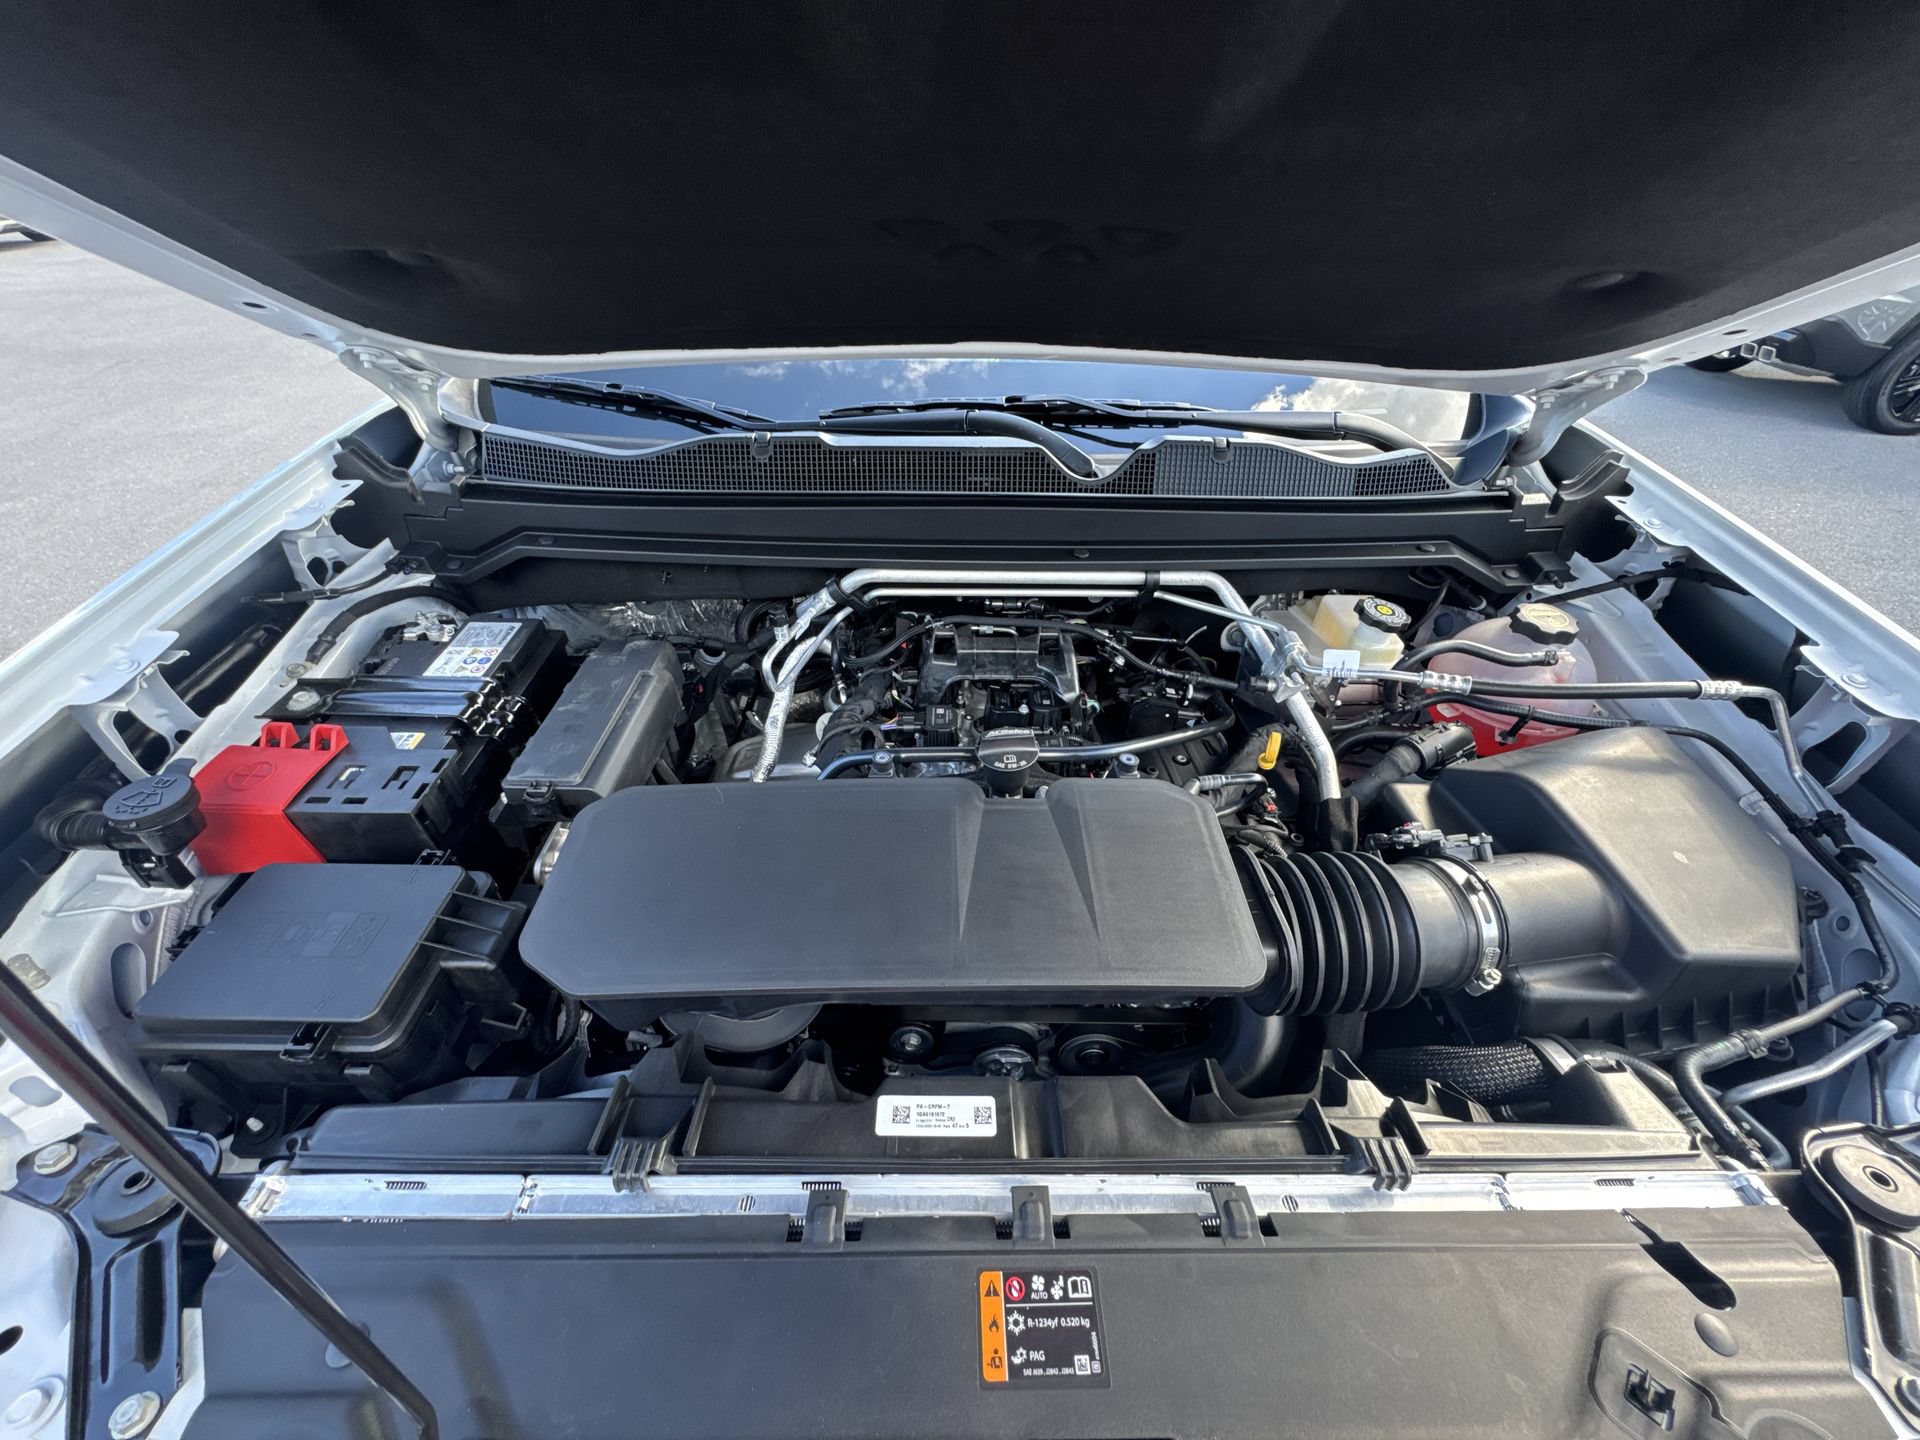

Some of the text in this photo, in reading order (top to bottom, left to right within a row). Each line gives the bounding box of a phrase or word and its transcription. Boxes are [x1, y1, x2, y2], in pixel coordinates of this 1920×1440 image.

[985, 729, 1030, 738] ACDelco
[994, 761, 1005, 769] SAE
[1031, 1292, 1048, 1300] AUTO
[1027, 1316, 1090, 1329] R-1234yf 0.520 kg
[1029, 1350, 1046, 1361] PAG
